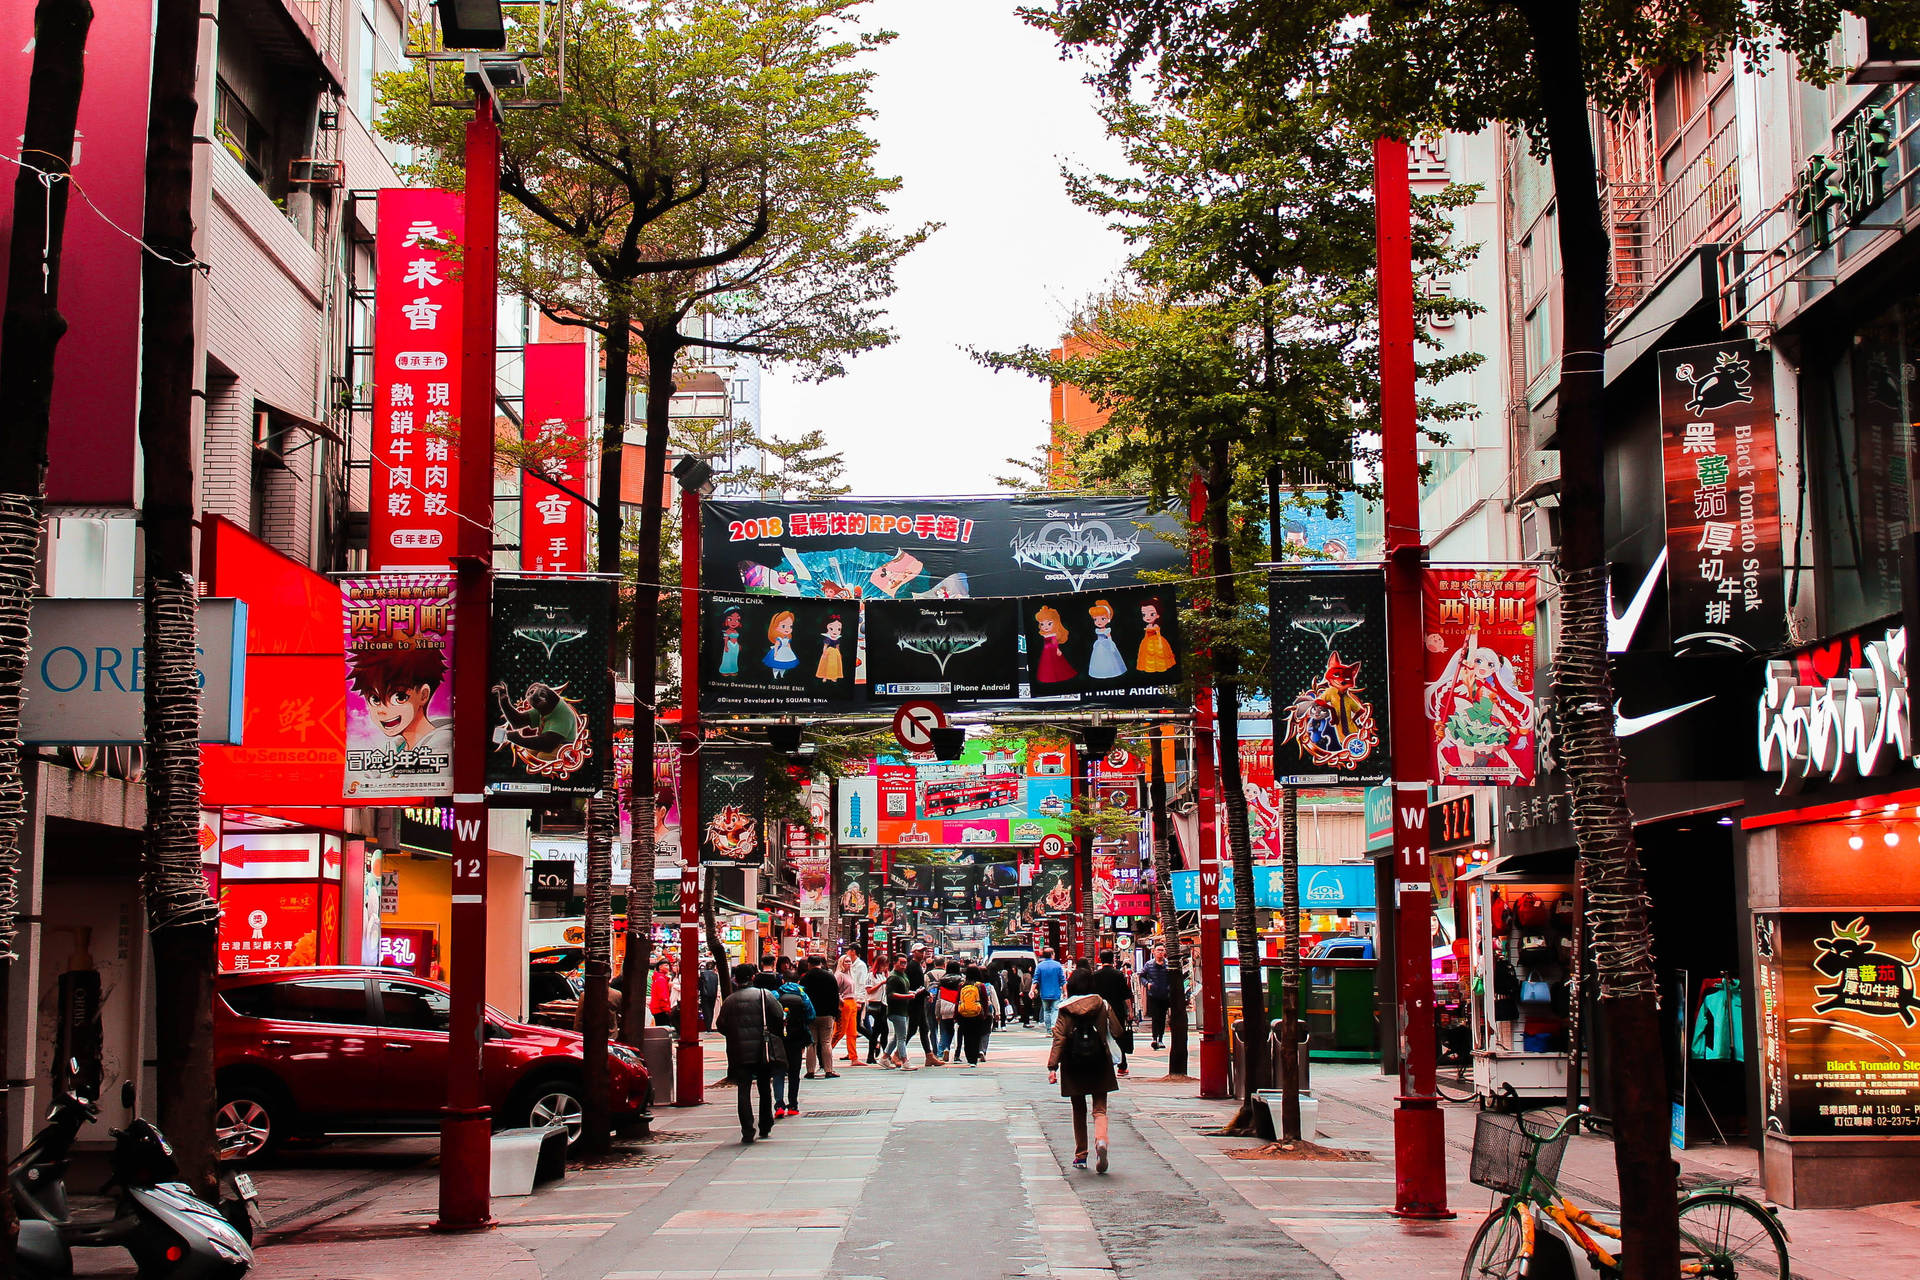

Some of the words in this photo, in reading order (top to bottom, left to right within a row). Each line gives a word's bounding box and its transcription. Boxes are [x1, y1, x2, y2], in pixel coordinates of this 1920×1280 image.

[402, 221, 448, 330] 永来香
[398, 355, 445, 366] 傳承手作
[387, 383, 414, 517] 熱銷牛肉乾
[1734, 425, 1752, 476] Black
[1044, 509, 1070, 519] Disney
[1738, 482, 1756, 553] Tomato
[729, 516, 783, 542] 2018
[1683, 423, 1742, 625] 黑蕃茄厚切牛排
[392, 534, 440, 545] 百年老店
[1742, 558, 1764, 612] Steak
[1438, 597, 1526, 625] 西門町
[349, 604, 451, 639] 西門町
[352, 641, 394, 650] Welcome
[398, 641, 409, 650] to
[416, 640, 446, 650] Ximen
[954, 684, 979, 692] iPhone
[981, 683, 1010, 692] Android
[346, 746, 449, 774] 冒險少年浩平
[1372, 794, 1393, 825] wats
[1401, 807, 1425, 830] W
[1443, 798, 1471, 841] 322
[456, 820, 480, 842] W
[1045, 841, 1059, 852] 30
[1402, 846, 1425, 865] 11
[454, 859, 480, 878] 12
[538, 874, 568, 886] 50%
[682, 881, 696, 894] W
[1202, 873, 1216, 885] W
[681, 903, 697, 913] 14
[1203, 895, 1218, 905] 13
[234, 954, 280, 970] 第一名
[1844, 964, 1896, 982] 黑蕃茄
[1842, 980, 1900, 999] 厚切牛排
[1826, 1061, 1857, 1071] Black
[1859, 1061, 1901, 1071] Tomato
[1903, 1061, 1920, 1071] Ste
[1877, 1106, 1900, 1114] 11:00
